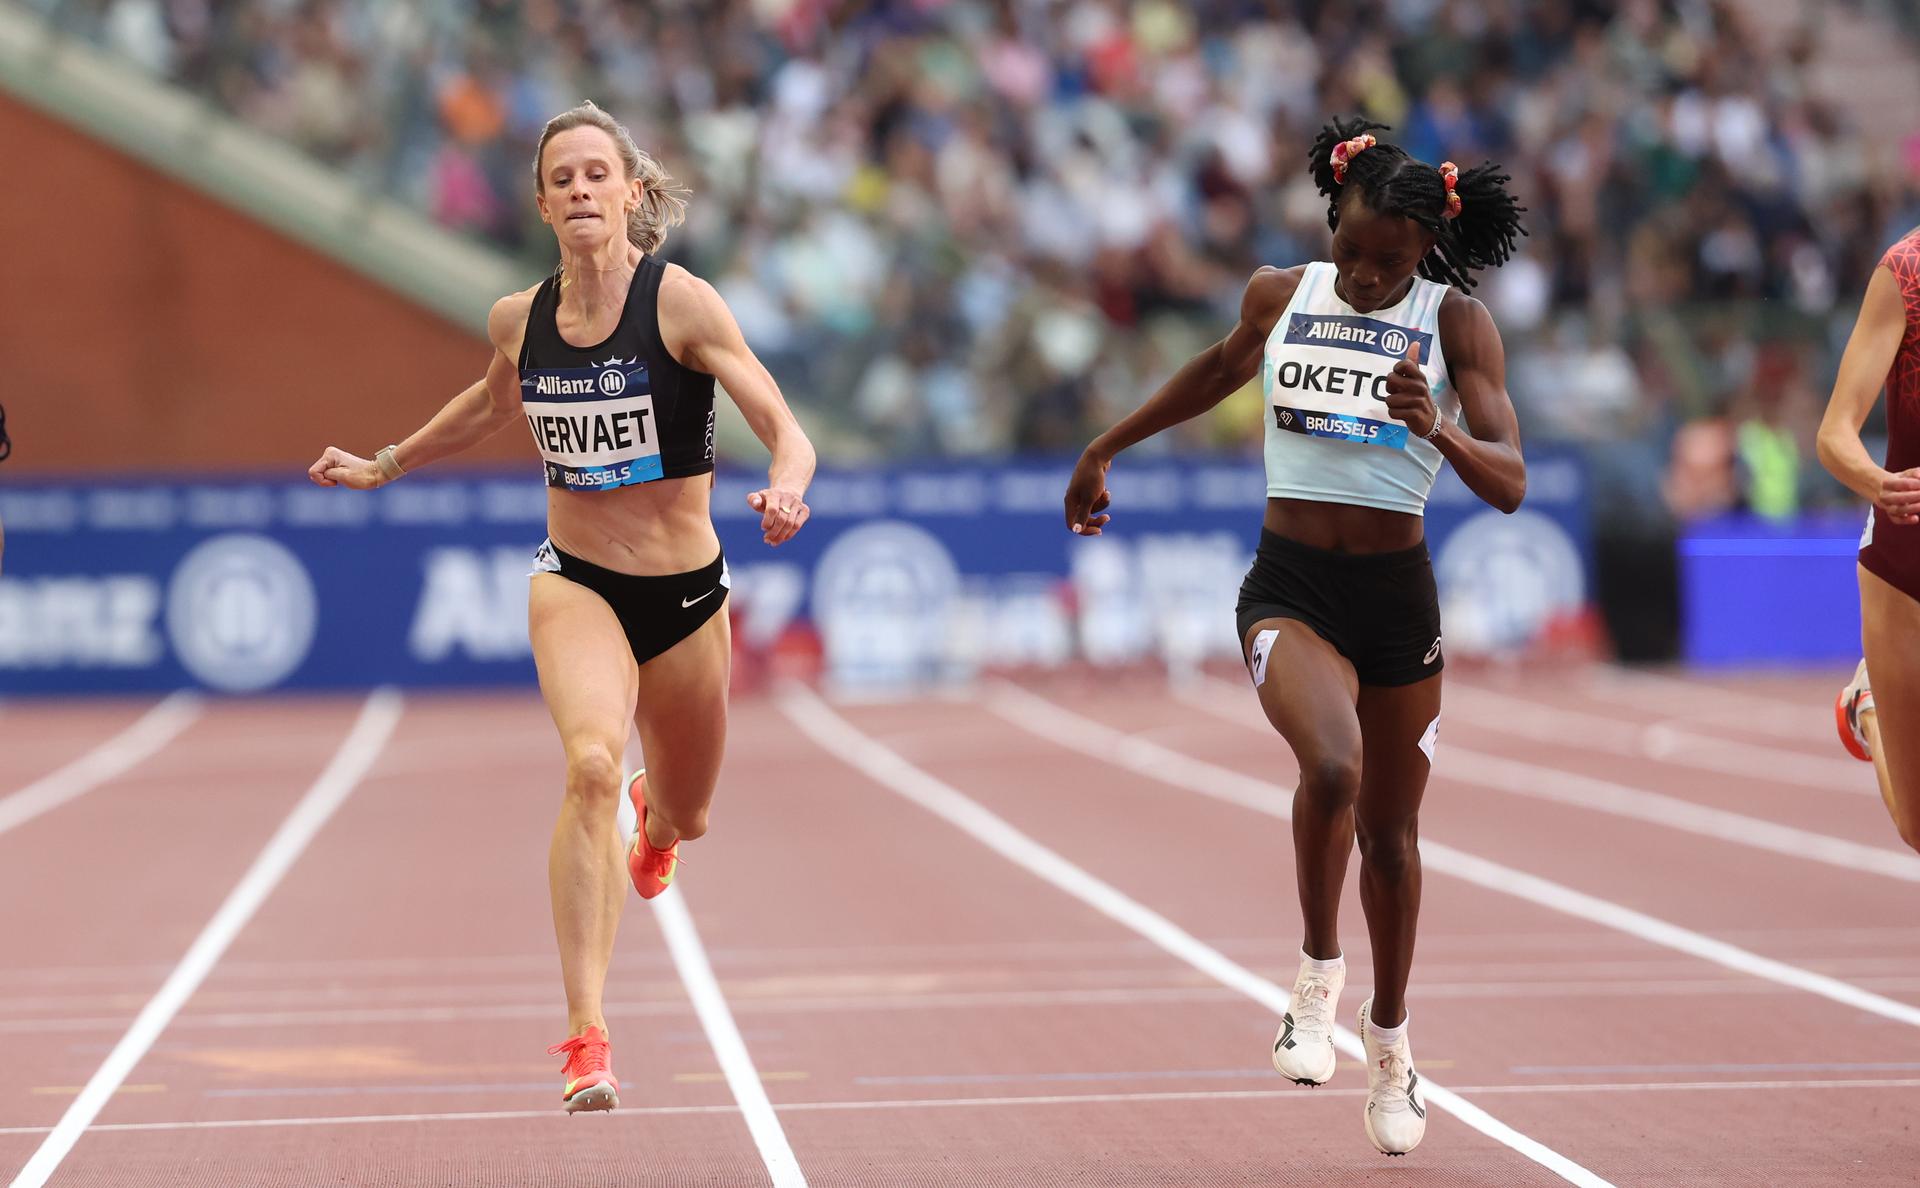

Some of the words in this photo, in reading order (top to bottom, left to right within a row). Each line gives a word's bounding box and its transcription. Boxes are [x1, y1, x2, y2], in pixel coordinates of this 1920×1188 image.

[1306, 321, 1378, 346] Allianz
[536, 375, 596, 395] Allianz
[528, 408, 649, 454] VERVAET
[1305, 416, 1379, 438] BRUSSELS
[564, 466, 632, 487] BRUSSELS
